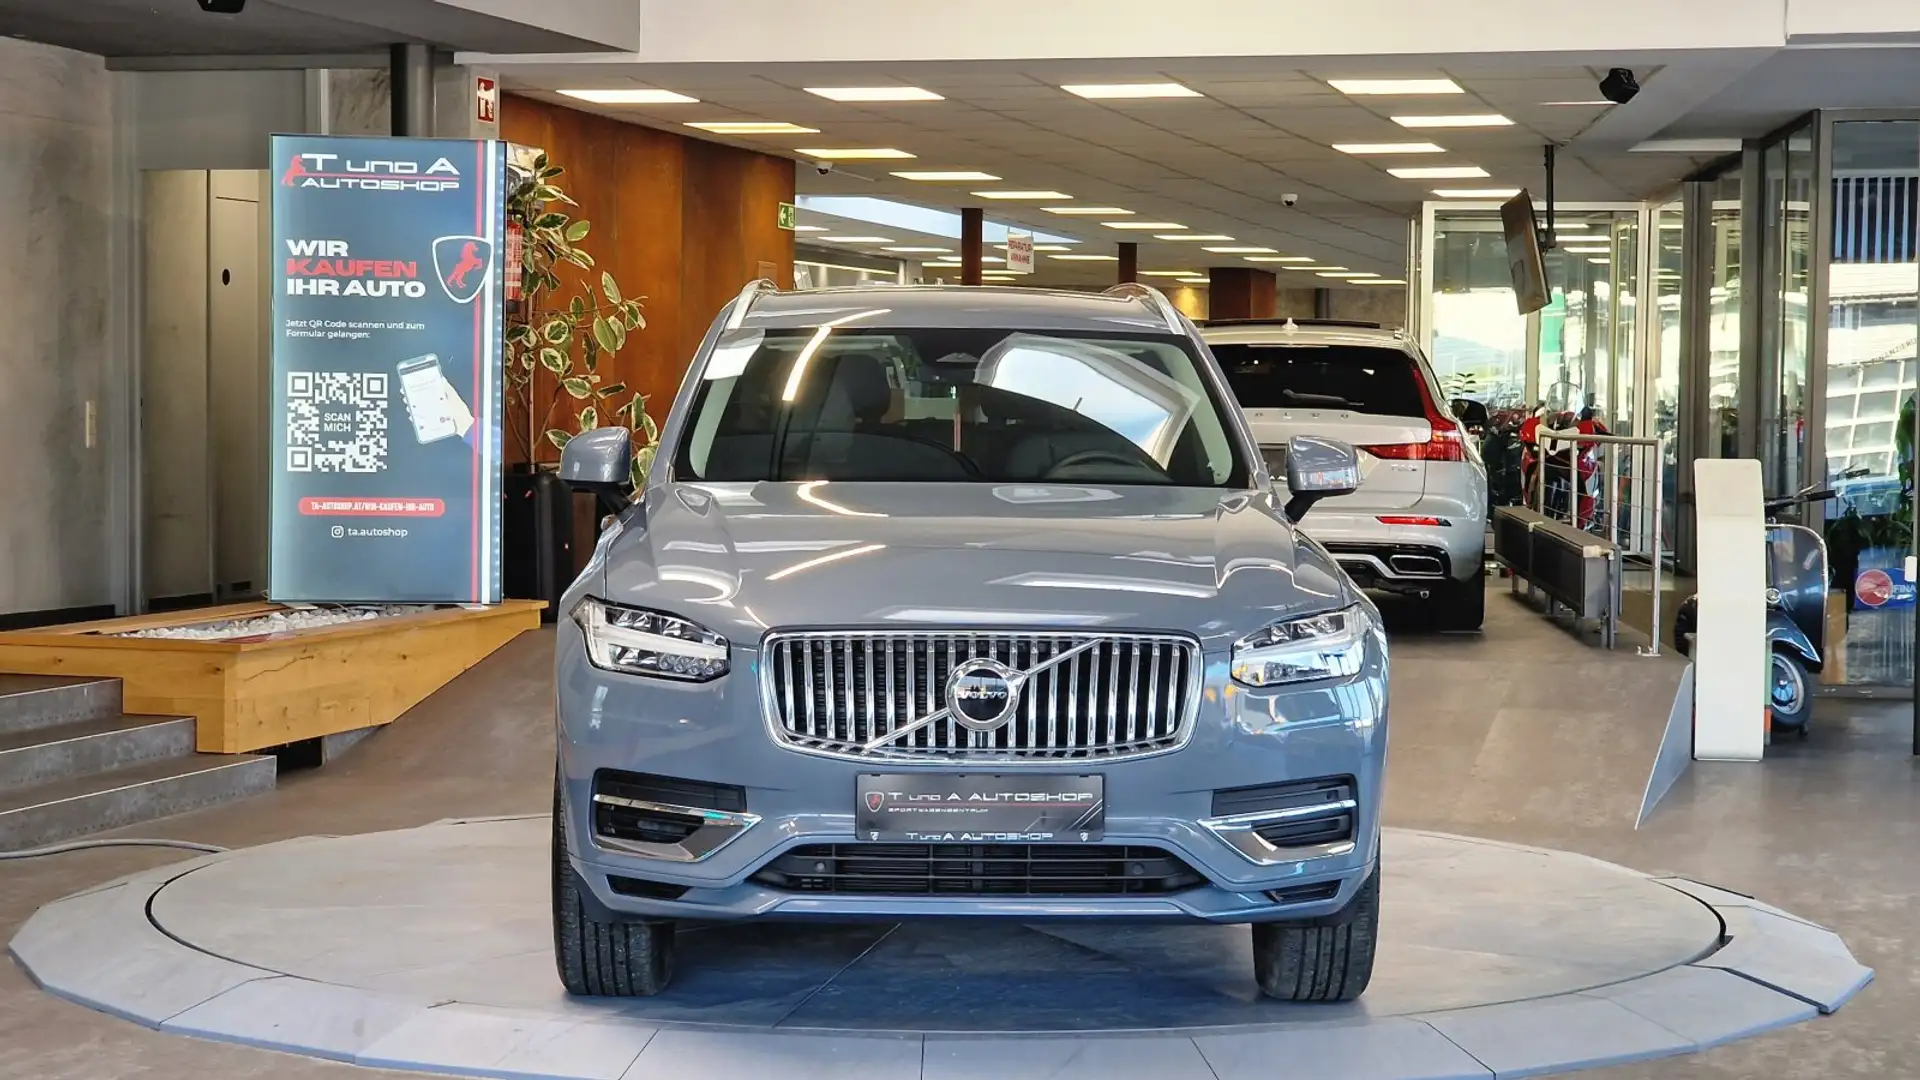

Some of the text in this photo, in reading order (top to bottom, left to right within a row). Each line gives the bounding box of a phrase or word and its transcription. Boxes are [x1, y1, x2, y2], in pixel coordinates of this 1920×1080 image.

[301, 153, 338, 172] T
[425, 157, 460, 175] A
[301, 177, 460, 192] AUTOSHOP
[286, 238, 348, 257] WIR
[286, 258, 417, 278] KAUFEN
[286, 278, 426, 298] IHR AUTO
[286, 319, 425, 330] Jetzt QR Code scannen und zum
[286, 329, 371, 340] Formular gelangen:
[323, 412, 352, 422] SCAN
[323, 422, 352, 432] MICH
[347, 526, 408, 538] ta.autoshop
[957, 690, 1008, 699] VOLVO
[888, 792, 903, 801] T
[946, 792, 962, 801] A
[968, 792, 1093, 802] AUTOSHOP
[960, 832, 1054, 841] AUTOSHOP
